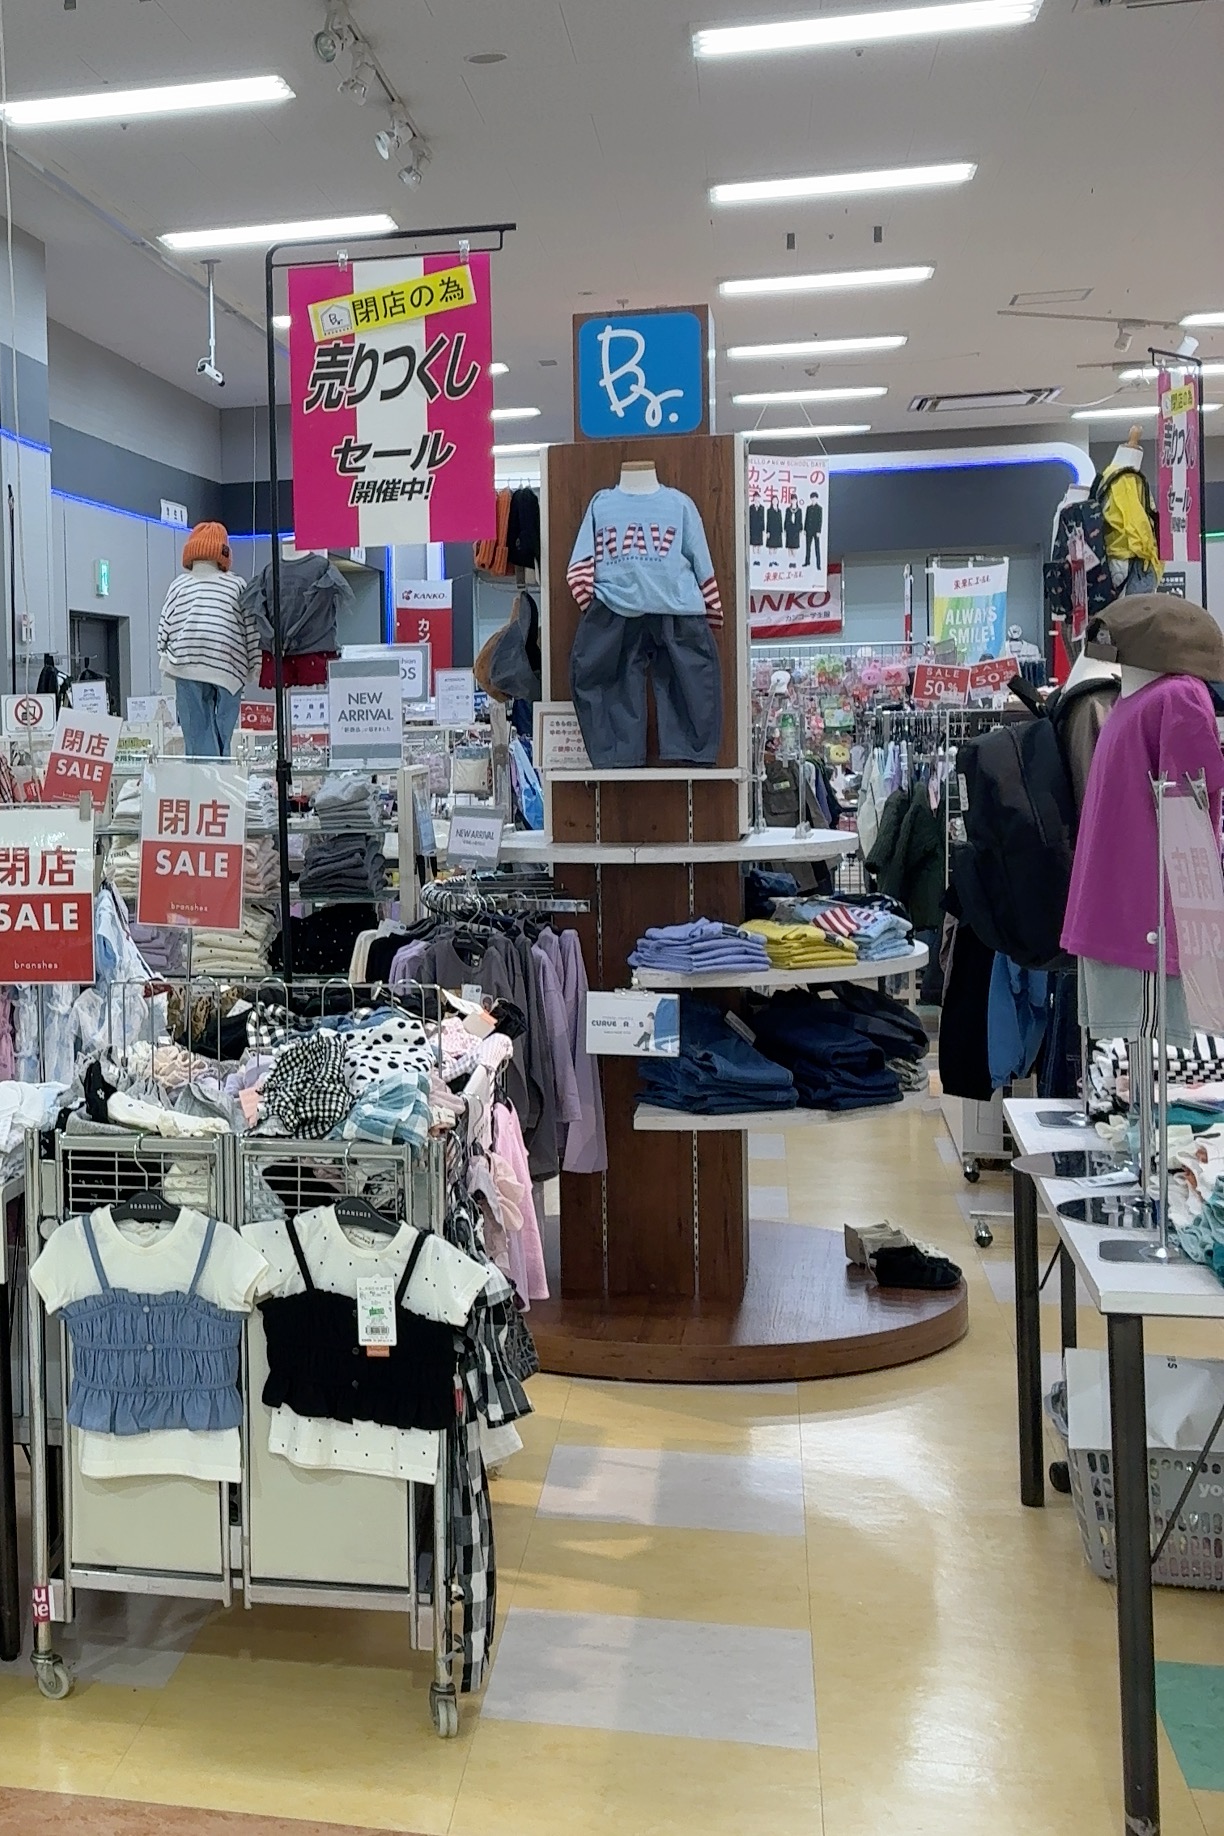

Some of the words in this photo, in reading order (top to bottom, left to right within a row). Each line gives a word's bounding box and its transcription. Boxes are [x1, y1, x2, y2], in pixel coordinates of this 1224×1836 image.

[351, 277, 465, 326] 閉店の為
[304, 333, 480, 413] 売りつくし
[331, 430, 457, 475] セール
[748, 466, 826, 485] カンコーの
[348, 477, 433, 506] 開催中!
[945, 606, 998, 625] ALWAYS
[948, 625, 996, 645] SMILE!
[926, 667, 960, 678] SALE
[976, 672, 1000, 685] 50
[348, 692, 383, 705] NEW
[338, 708, 394, 723] ARRIVAL
[61, 728, 110, 757] 閉店
[56, 759, 104, 782] SALE
[157, 798, 231, 838] 閉店
[455, 829, 471, 838] NEW
[155, 850, 230, 878] SALE
[169, 902, 209, 912] branshes
[14, 959, 59, 970] branshes
[591, 1020, 618, 1028] CURVE
[337, 1208, 372, 1218] BRANSHES
